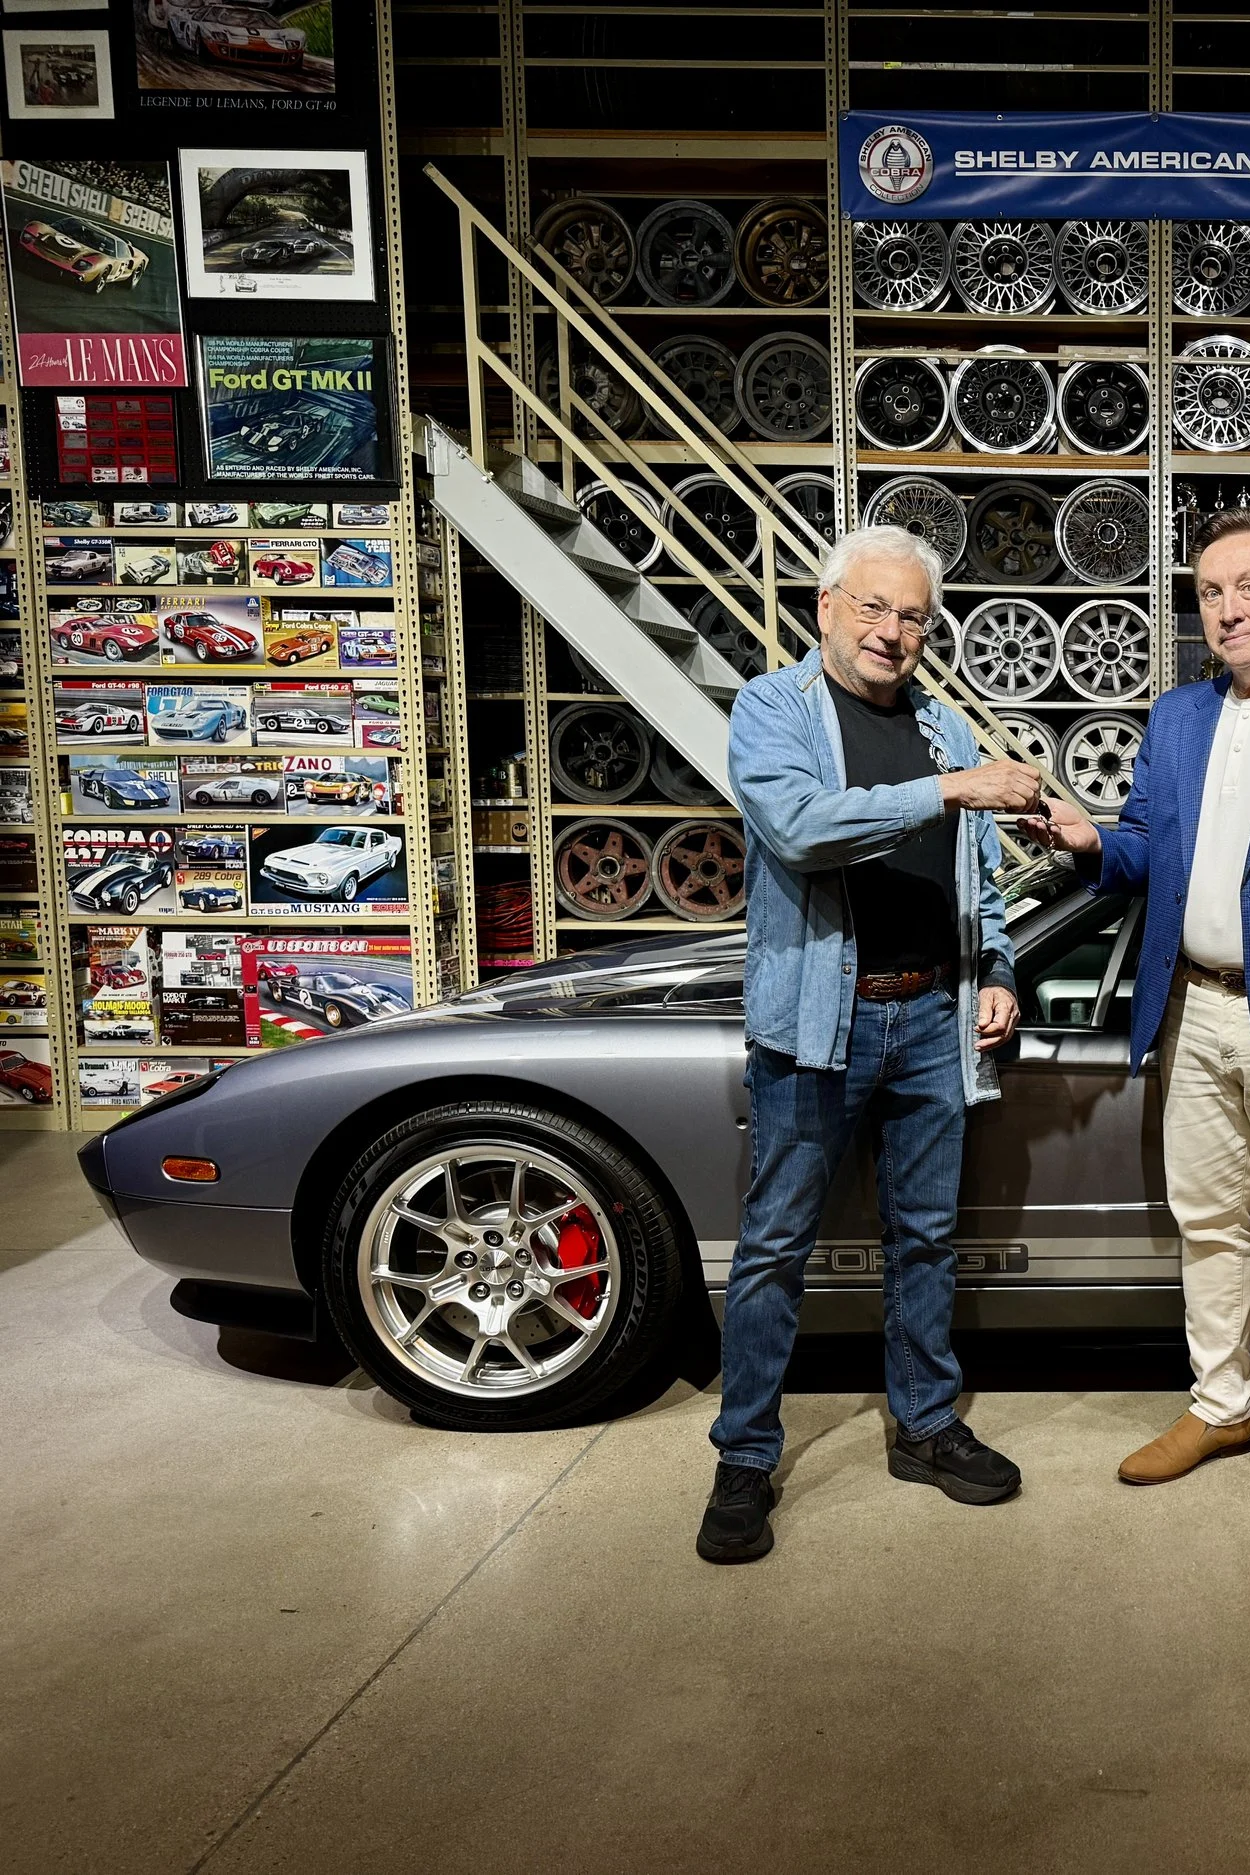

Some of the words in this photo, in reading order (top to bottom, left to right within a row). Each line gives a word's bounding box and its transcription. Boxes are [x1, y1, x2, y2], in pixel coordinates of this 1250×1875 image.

[140, 96, 192, 107] LEGENDE
[196, 97, 213, 108] DU
[217, 98, 267, 110] LEMANS,
[271, 99, 302, 110] FORD
[305, 100, 322, 110] GT
[324, 100, 337, 111] 40
[860, 130, 886, 163] SHELBY
[889, 126, 932, 162] AMERICAN
[955, 151, 1079, 169] SHELBY
[870, 167, 921, 177] COBRA
[18, 164, 69, 206] SHELL
[69, 183, 109, 214] SHELL
[869, 183, 925, 202] COLLECTION
[28, 354, 46, 370] 24
[65, 338, 96, 382] LE
[101, 338, 177, 382] MANS
[209, 369, 267, 390] Ford
[272, 370, 308, 391] GT
[311, 371, 354, 391] MK
[357, 371, 372, 391] II
[161, 597, 205, 606] FERRARI
[72, 632, 83, 645] 20
[147, 687, 170, 696] FORD
[171, 687, 192, 697] GT40
[295, 718, 303, 727] 2
[285, 756, 332, 772] ZANO
[148, 771, 177, 783] SHELL
[63, 830, 147, 848] COBRA
[64, 847, 106, 861] 427
[193, 871, 211, 880] 289
[214, 871, 242, 881] Cobra
[290, 904, 360, 913] MUSTANG
[98, 927, 127, 936] MARK
[130, 927, 140, 936] IV
[267, 940, 286, 952] US
[287, 940, 339, 952] SPORTS
[340, 940, 369, 952] CAR
[92, 1000, 120, 1010] HOLMAN
[124, 1000, 150, 1010] MOODY
[150, 1064, 171, 1072] Cobra
